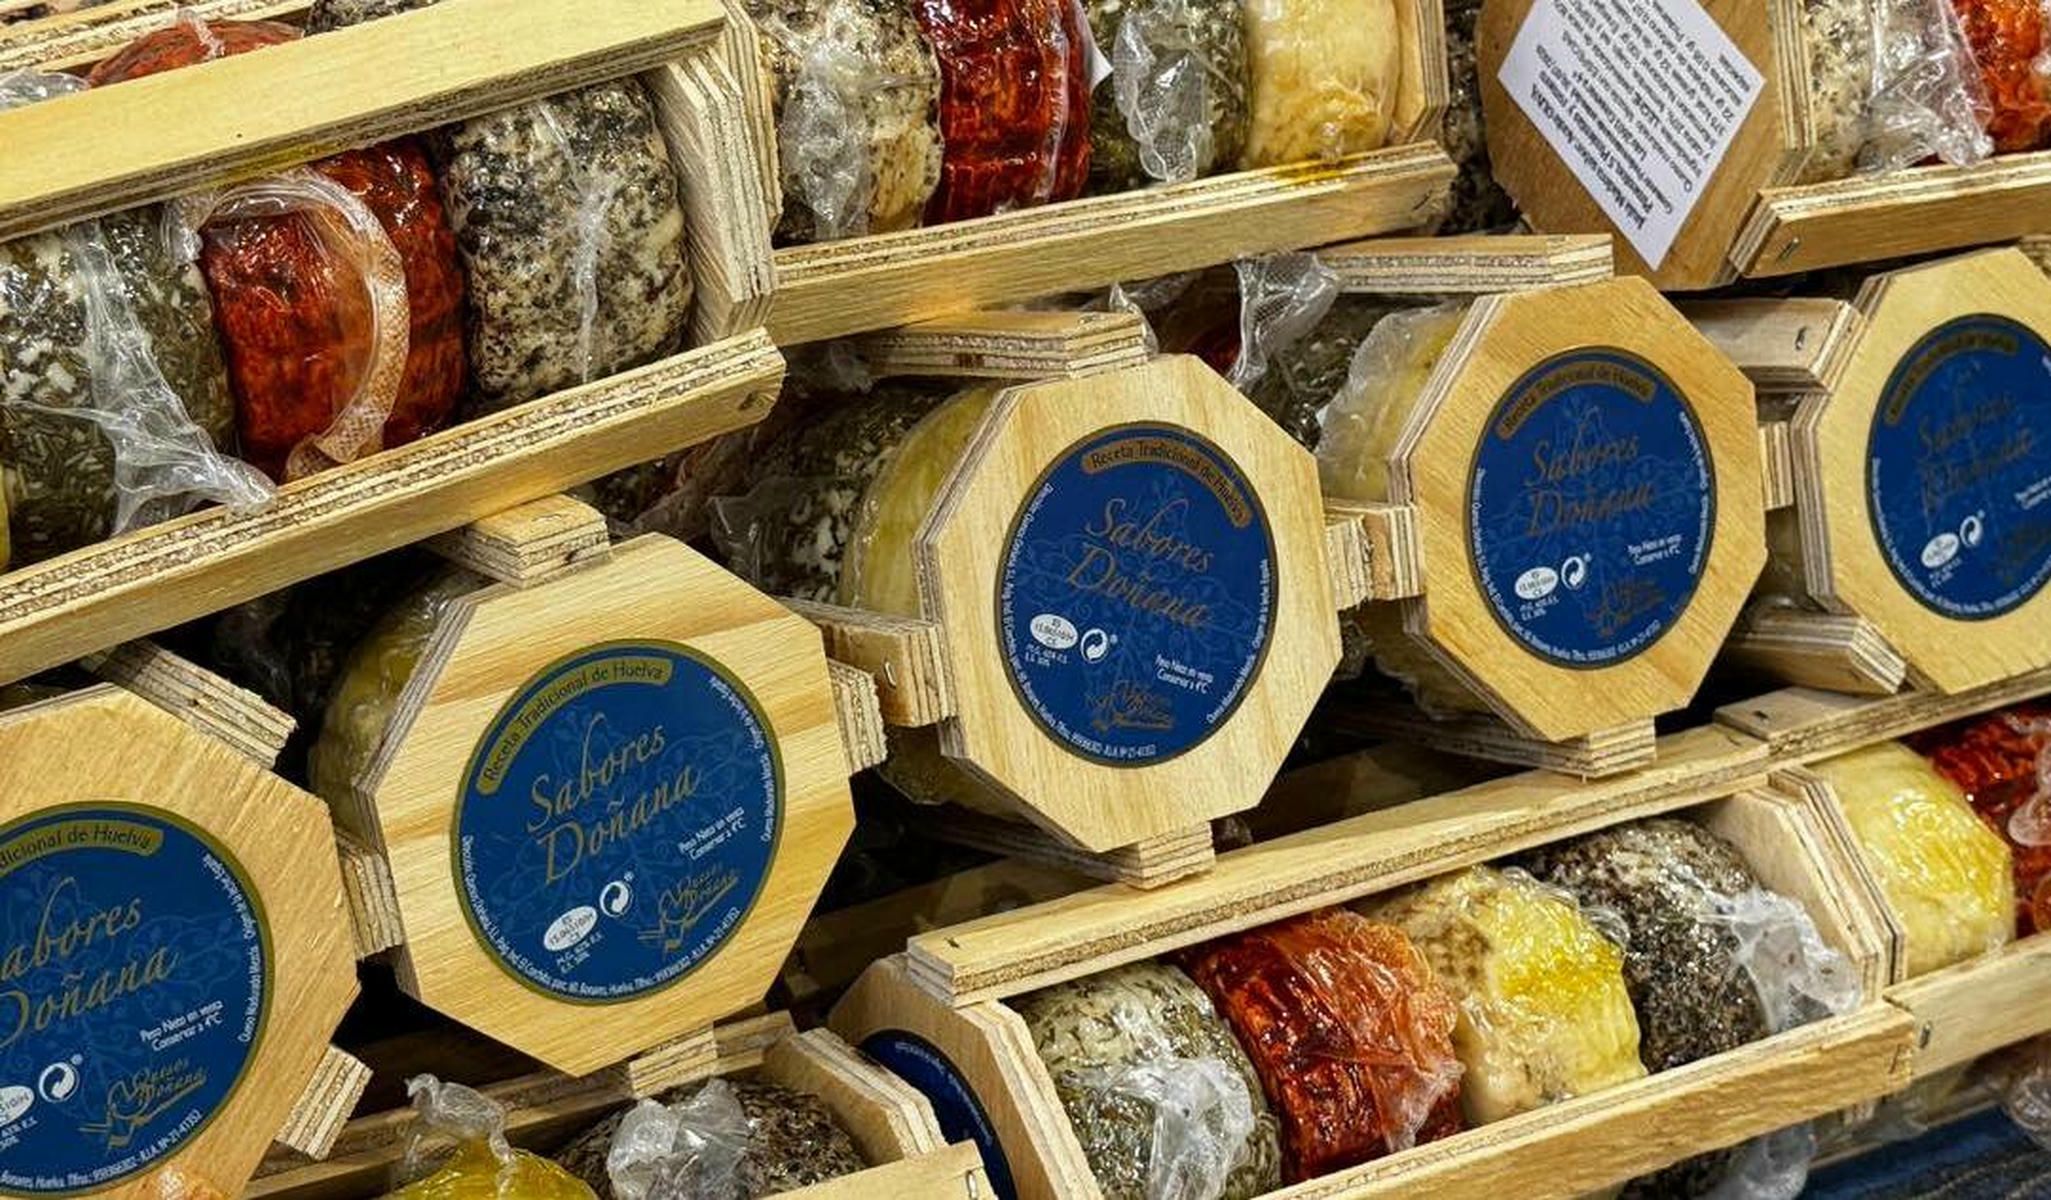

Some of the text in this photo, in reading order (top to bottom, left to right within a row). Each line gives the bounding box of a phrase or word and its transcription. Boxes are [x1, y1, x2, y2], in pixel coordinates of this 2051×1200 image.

[1089, 440, 1133, 470] Receta
[1085, 499, 1217, 573] Sabores
[1066, 545, 1211, 628] Doñana
[481, 661, 664, 782] Receta Tradicional de Huelva
[527, 712, 667, 832] Sabores
[0, 820, 154, 870] dicional de Huelva
[535, 765, 700, 886] Doñana
[0, 877, 142, 981] abores
[244, 973, 261, 1016] Madurado
[140, 1027, 162, 1042] Peso
[161, 1015, 186, 1032] Neto
[151, 1025, 196, 1052] Conservar
[236, 1015, 256, 1044] Queso
